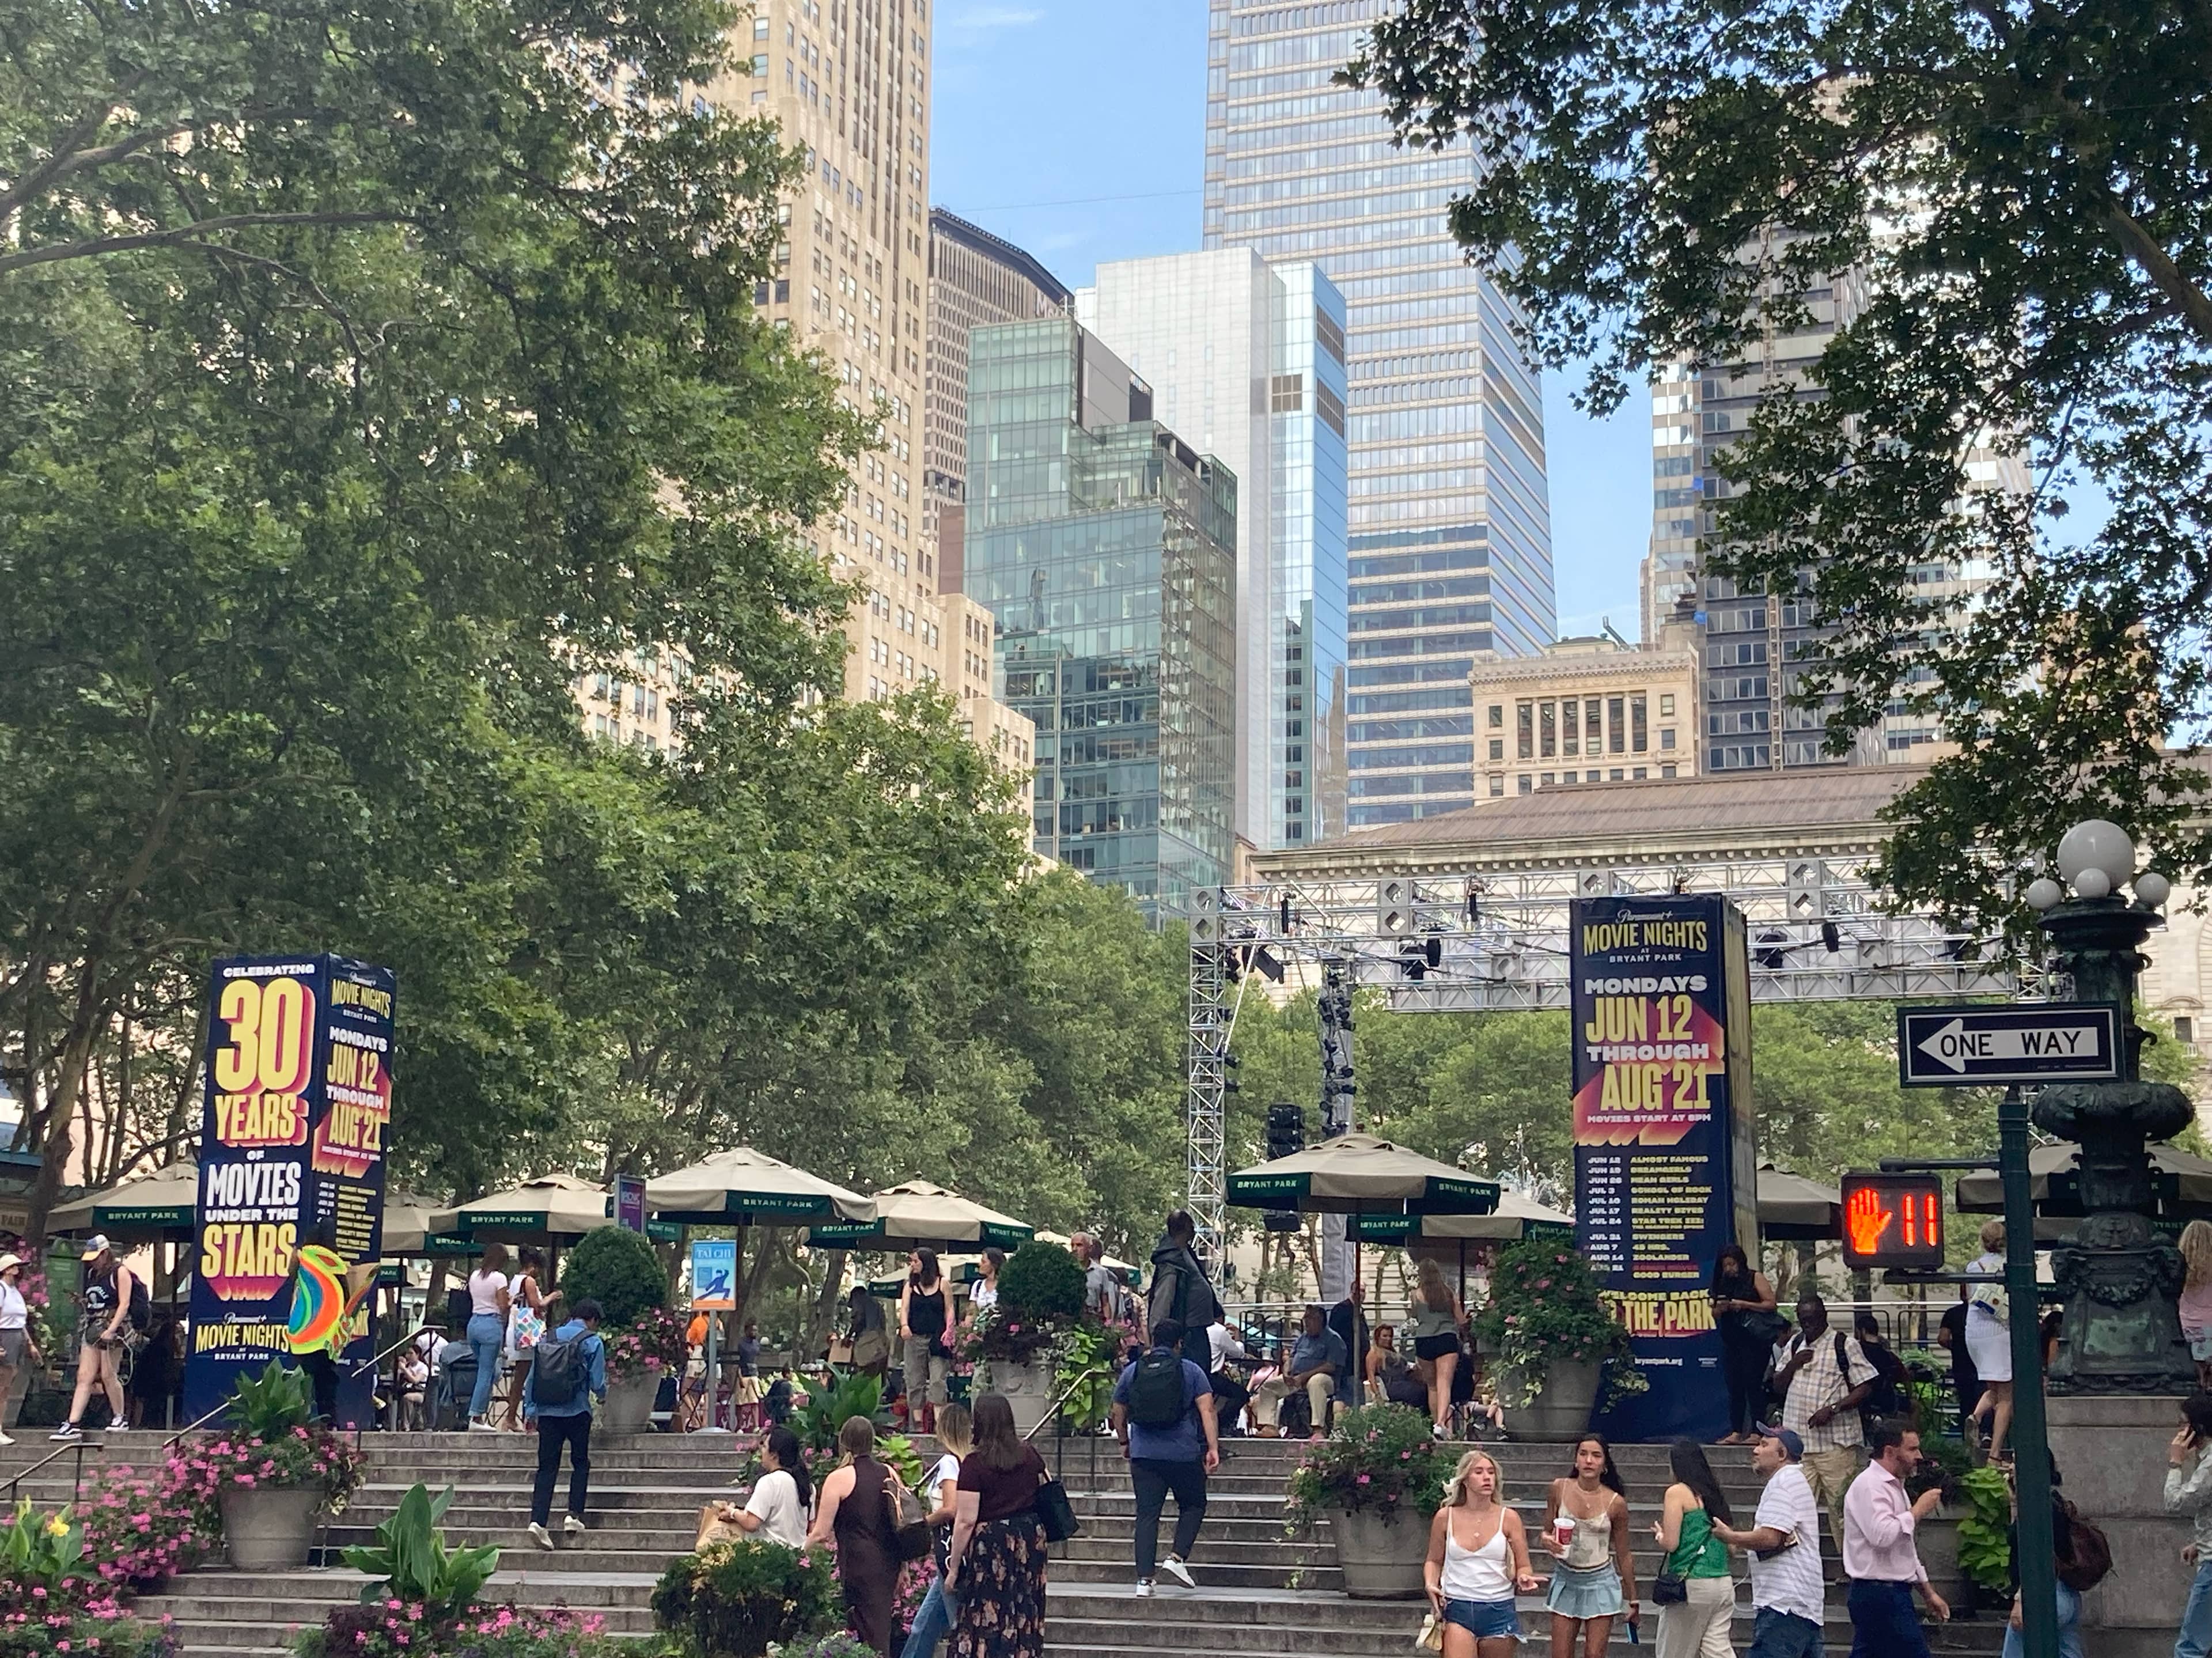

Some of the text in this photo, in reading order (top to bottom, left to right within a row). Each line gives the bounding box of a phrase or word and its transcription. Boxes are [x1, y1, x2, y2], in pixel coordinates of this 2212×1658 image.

[1583, 921, 1707, 956] MOVIE NIGHTS
[223, 964, 315, 978] CELEBRATING
[1609, 953, 1682, 963] BRYANT PARK
[1585, 975, 1708, 995] MONDAYS
[331, 979, 392, 1020] MOVIE NIGHTS
[1585, 994, 1693, 1043] JUN 12
[215, 977, 305, 1092] 30
[329, 1025, 388, 1053] MONDAYS
[1940, 1031, 2082, 1058] ONE WAY
[1586, 1043, 1710, 1062] THROUGH
[327, 1043, 380, 1092] JUN 12
[326, 1084, 384, 1110] THROUGH
[1600, 1062, 1711, 1111] AUG 21
[214, 1093, 298, 1141] YEARS
[328, 1103, 382, 1152] AUG 21
[1633, 1115, 1669, 1123] START
[246, 1150, 265, 1160] OF
[206, 1161, 302, 1206] MOVIES
[1470, 1188, 1493, 1197] PARK
[205, 1207, 299, 1222] UNDER THE
[743, 1198, 782, 1206] BRYANT
[855, 1223, 876, 1231] PARK
[1903, 1193, 1937, 1247] 11
[201, 1222, 297, 1278] STARS
[696, 1248, 731, 1258] TAI CHI
[1670, 1288, 1710, 1300] BACK
[1623, 1300, 1659, 1330] THE
[1664, 1298, 1717, 1330] PARK
[195, 1324, 289, 1354] MOVIE NIGHTS
